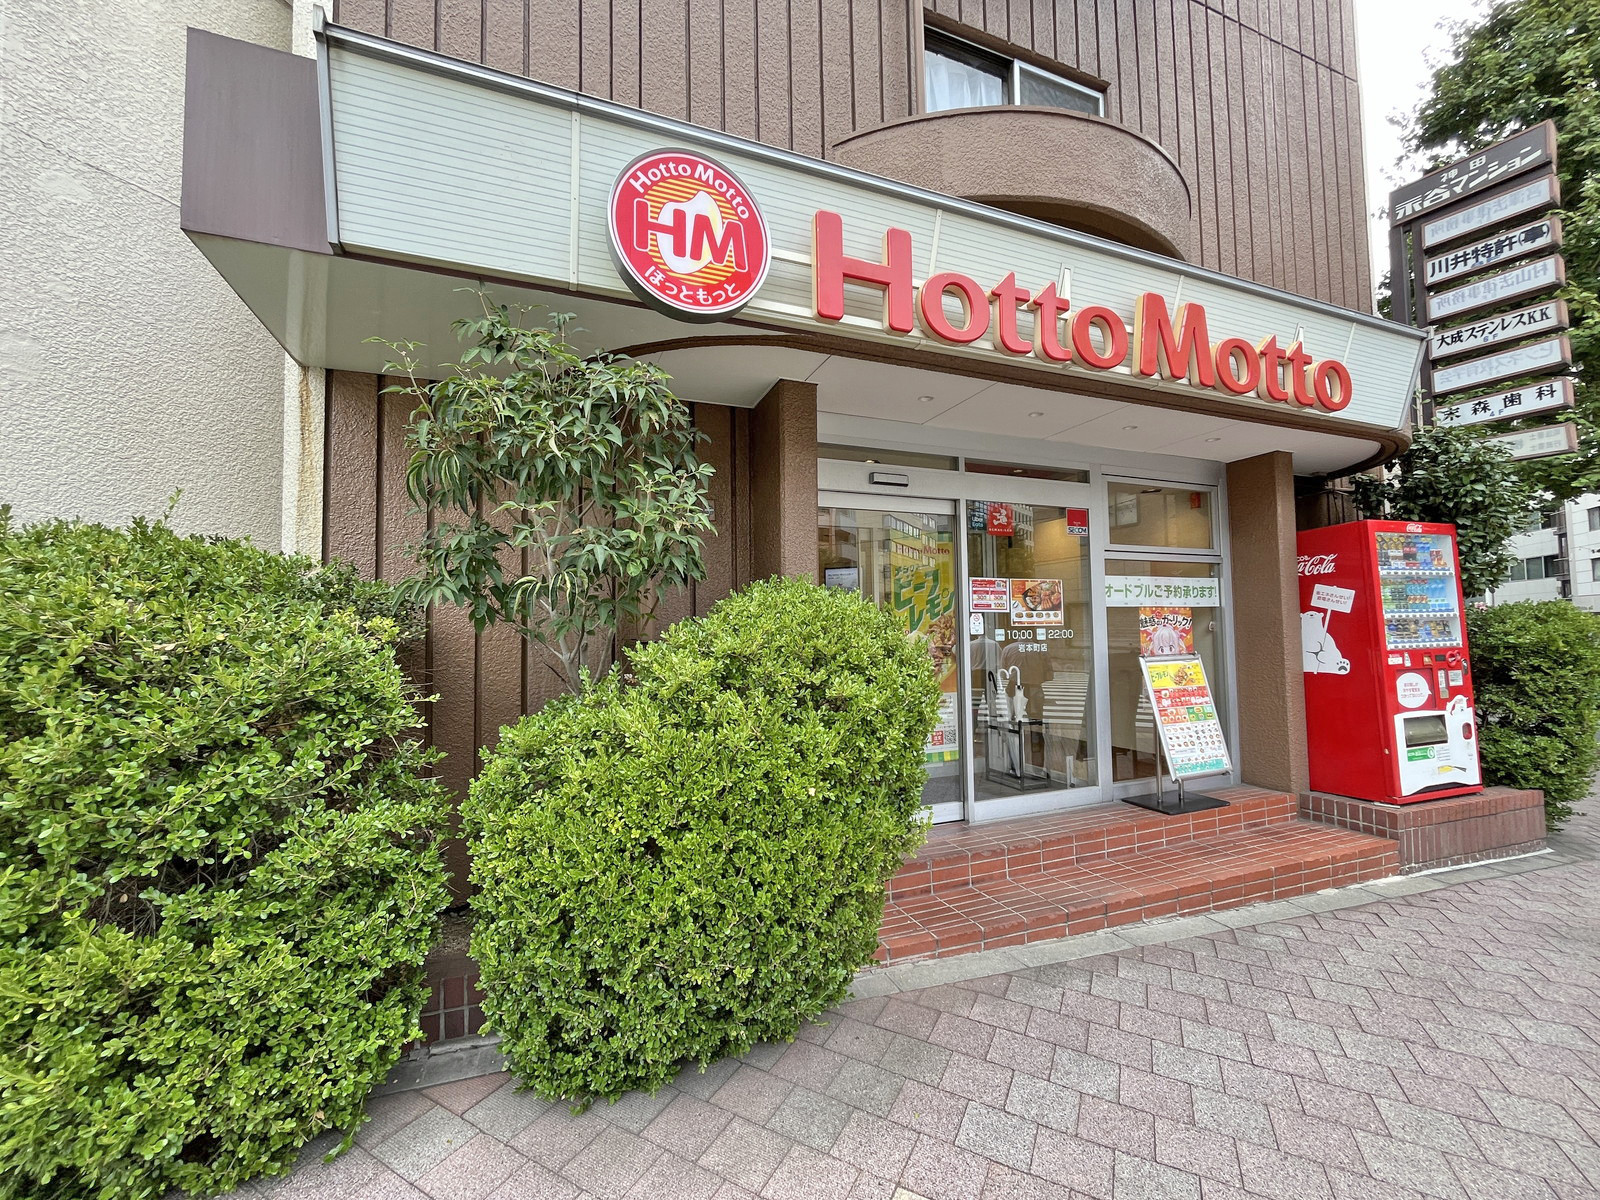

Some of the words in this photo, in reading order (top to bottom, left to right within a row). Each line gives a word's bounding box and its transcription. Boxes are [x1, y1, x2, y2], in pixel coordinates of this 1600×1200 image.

[1441, 155, 1486, 182] 神田
[629, 161, 691, 193] Hotto
[694, 163, 750, 219] Motto
[633, 198, 749, 273] HM
[644, 265, 741, 305] ほっともっと
[811, 208, 1129, 371] Hotto
[1131, 291, 1353, 413] Motto
[1437, 306, 1552, 349] 大成ステンレスKK
[1105, 583, 1217, 599] オードブルご予約承ります!
[1007, 630, 1033, 639] 10:00
[1048, 629, 1074, 639] 22:00
[1018, 643, 1048, 652] 岩本町店
